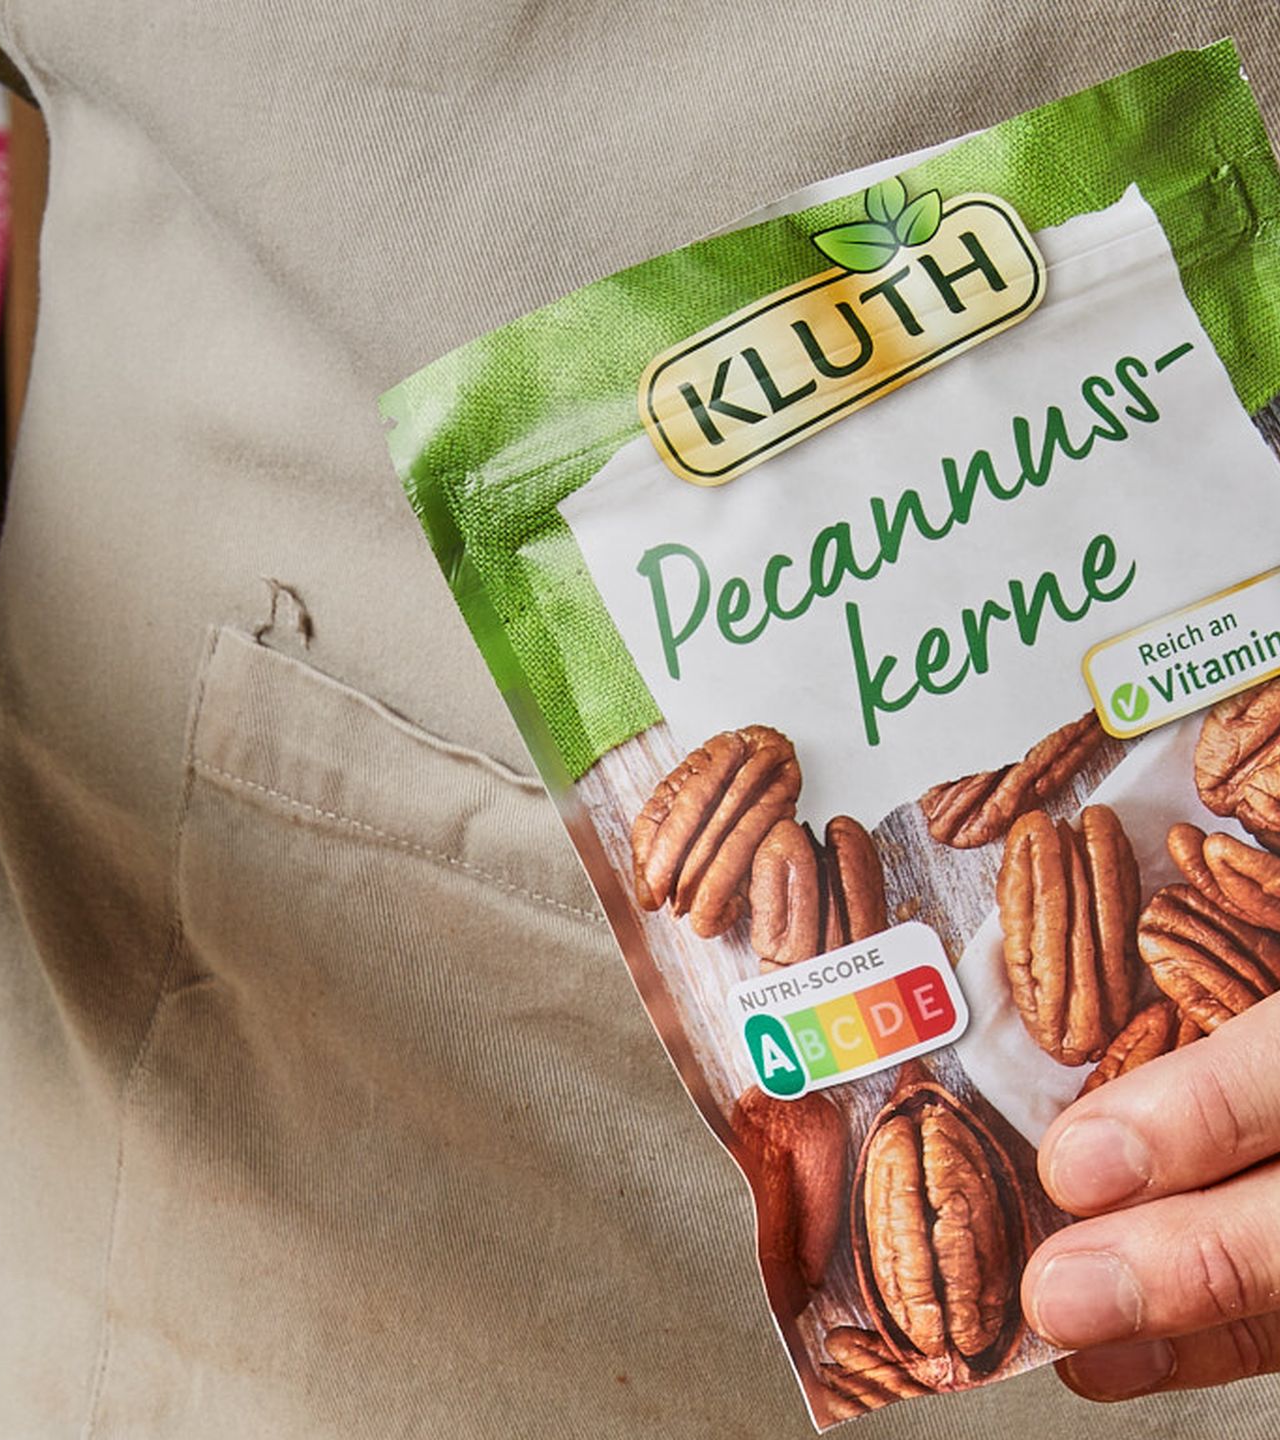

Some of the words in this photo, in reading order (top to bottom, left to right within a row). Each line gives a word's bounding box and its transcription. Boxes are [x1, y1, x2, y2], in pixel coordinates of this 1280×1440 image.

[678, 231, 1008, 446] KLUTH
[636, 342, 1195, 681] Pecannuss-
[845, 533, 1137, 747] kerne
[1138, 622, 1205, 667] Reich
[1210, 612, 1238, 638] an
[738, 948, 885, 1012] NUTRI-SCORE
